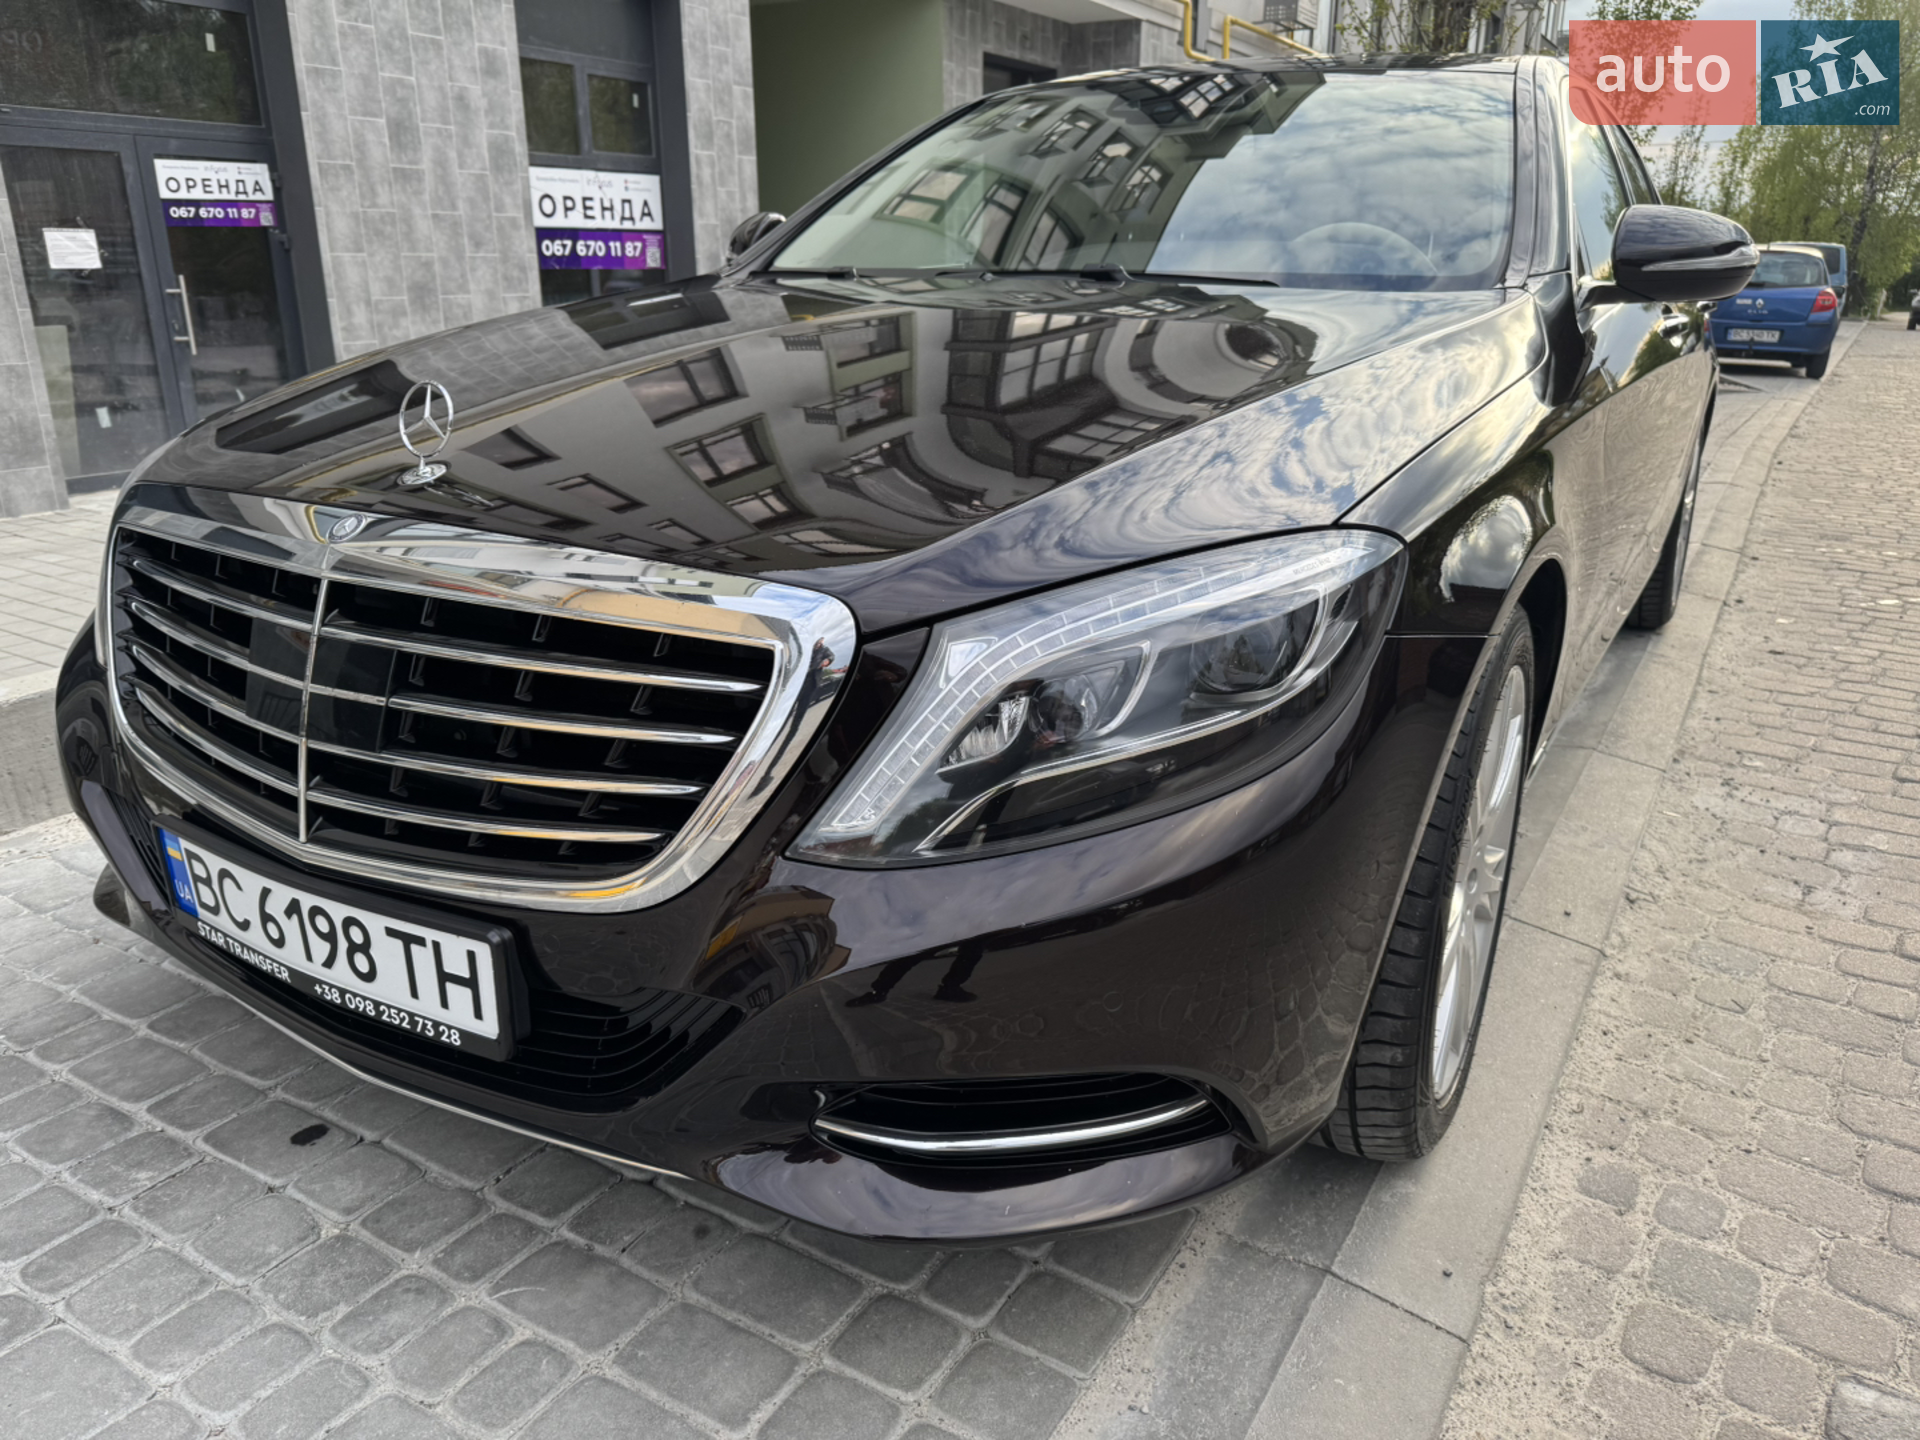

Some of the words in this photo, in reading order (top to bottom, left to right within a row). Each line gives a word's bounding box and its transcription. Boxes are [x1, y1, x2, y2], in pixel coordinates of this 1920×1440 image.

[165, 176, 266, 198] ОРЕНДА
[169, 206, 196, 218] 067
[198, 207, 224, 219] 670
[226, 208, 238, 219] 11
[241, 208, 256, 219] 87
[538, 193, 655, 226] ОРЕНДА
[541, 239, 572, 256] 067
[576, 240, 606, 257] 670
[608, 241, 621, 257] 11
[625, 241, 642, 257] 87
[174, 879, 194, 904] UA
[184, 847, 251, 932] BC
[258, 886, 378, 984] 6198
[384, 926, 484, 1022] TH
[197, 921, 228, 950] STAR
[226, 938, 291, 983] TRANSFER
[314, 983, 342, 1004] +38
[345, 993, 376, 1016] 098
[380, 1005, 411, 1029] 252
[414, 1016, 435, 1037] 73
[438, 1025, 461, 1046] 28
